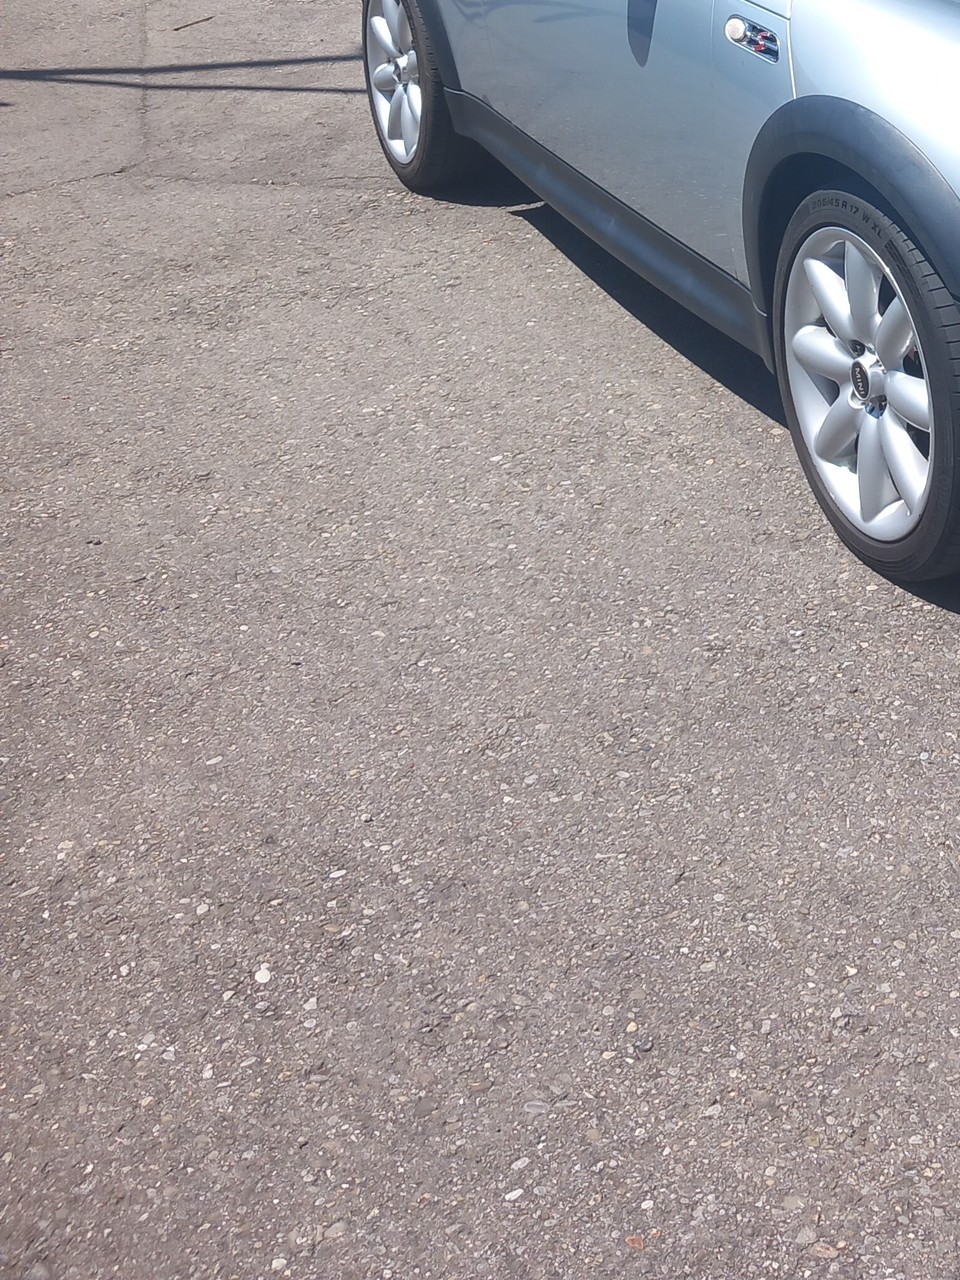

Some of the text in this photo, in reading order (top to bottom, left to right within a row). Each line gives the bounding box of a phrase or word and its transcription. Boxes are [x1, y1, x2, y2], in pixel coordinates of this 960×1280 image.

[841, 200, 848, 210] R
[850, 205, 859, 214] 17
[862, 211, 870, 223] W
[855, 367, 865, 394] MINI
